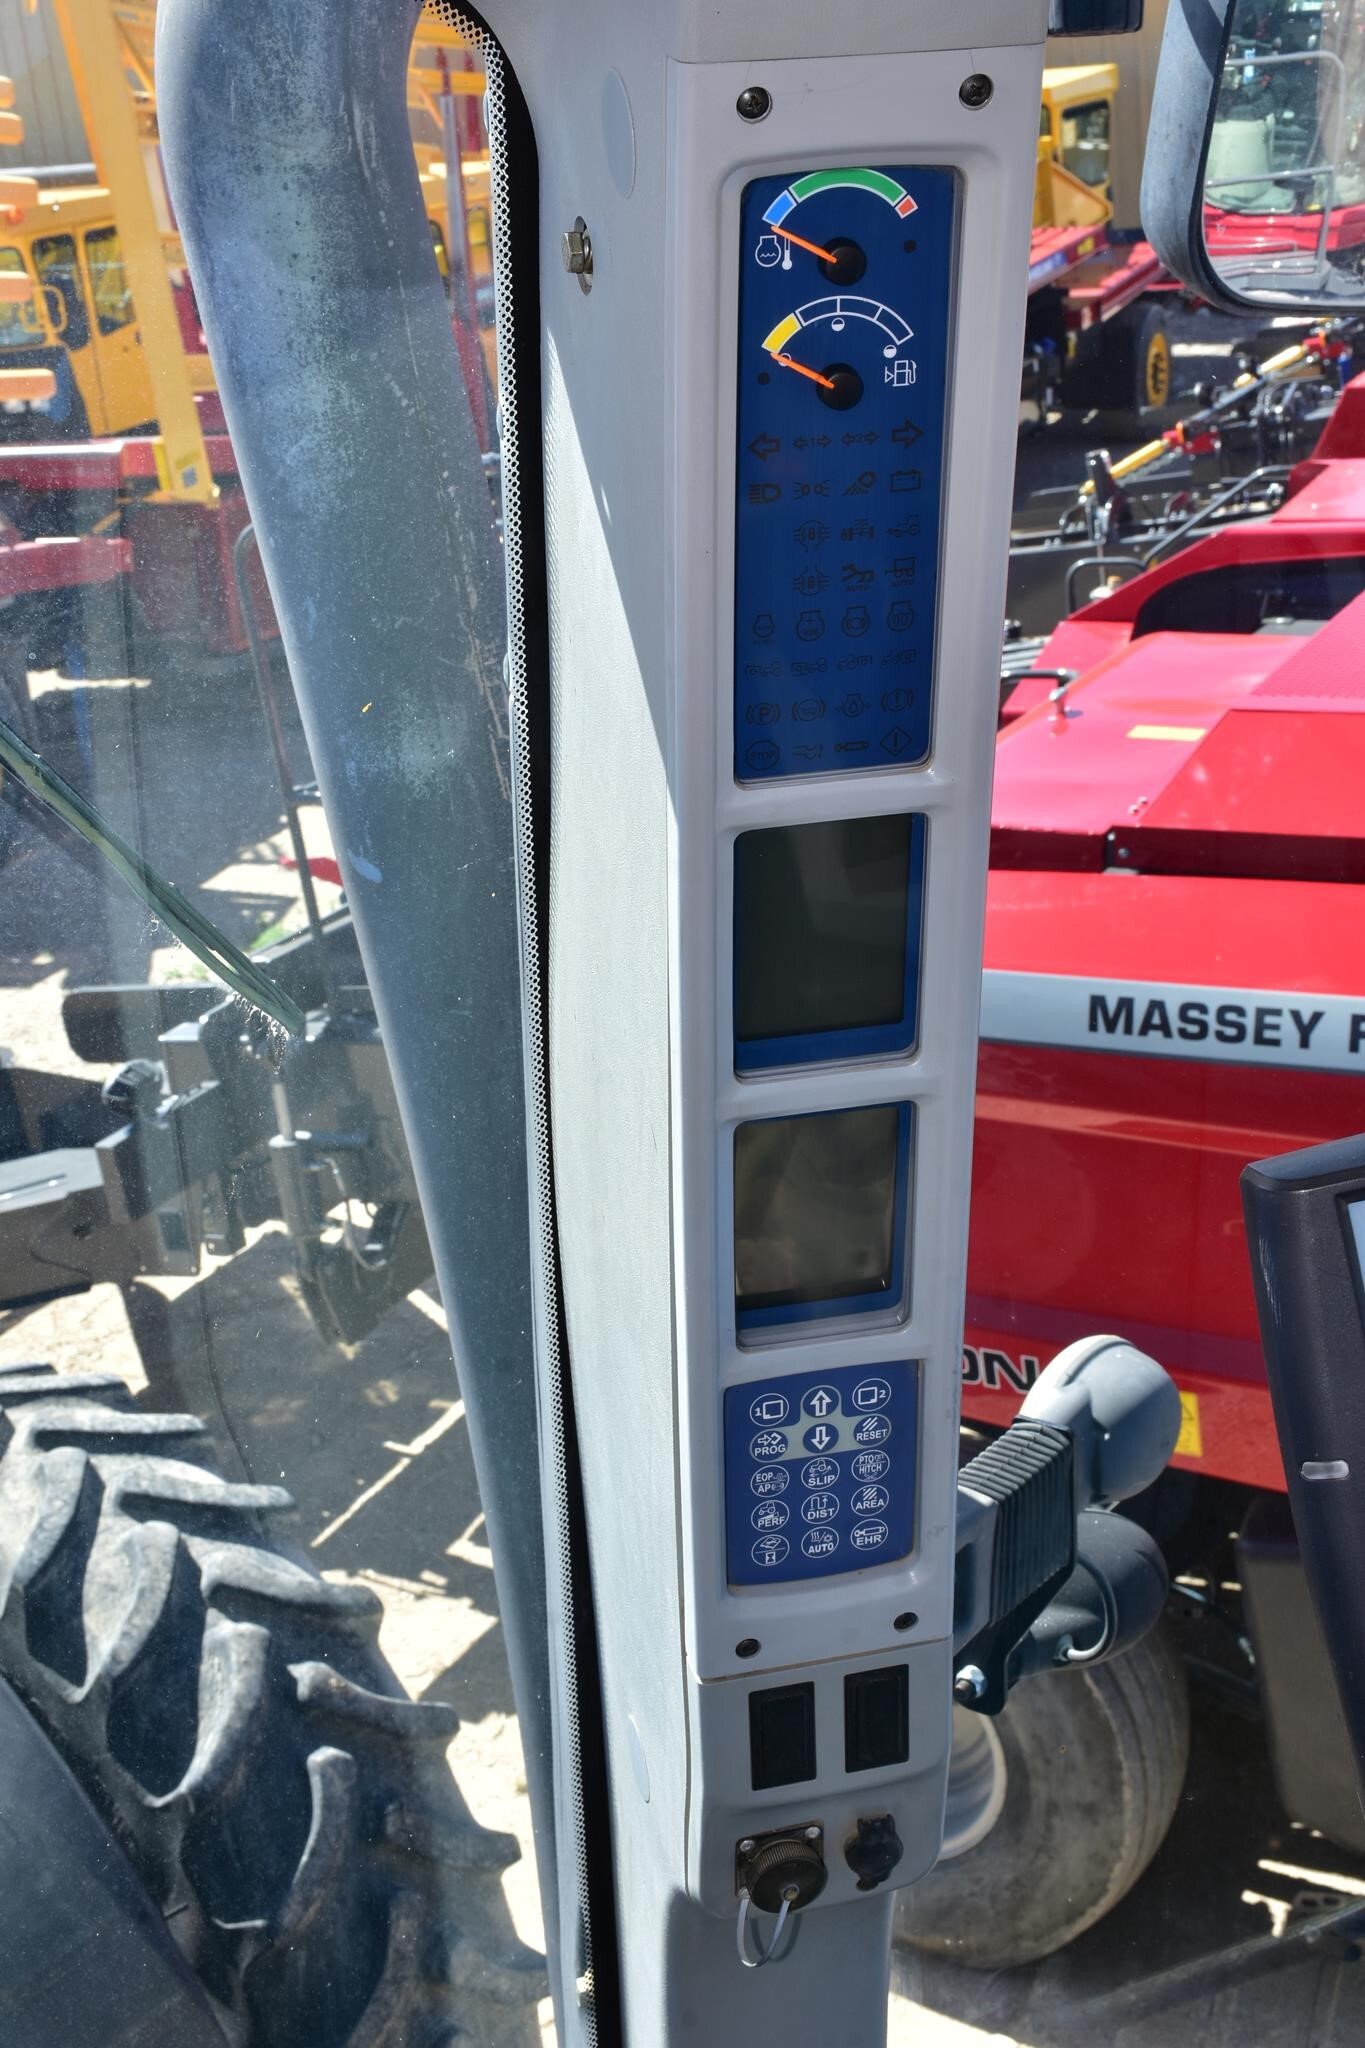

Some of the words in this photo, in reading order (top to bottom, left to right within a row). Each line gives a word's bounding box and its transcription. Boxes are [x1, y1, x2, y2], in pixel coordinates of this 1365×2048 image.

[1088, 994, 1326, 1050] MASSEY
[879, 1390, 886, 1399] 2
[754, 1407, 762, 1417] 1
[856, 1428, 888, 1441] RESET
[754, 1444, 786, 1457] PROG
[859, 1454, 873, 1464] PTO
[859, 1463, 882, 1474] HITCH
[808, 1475, 835, 1487] SLIP
[855, 1499, 885, 1510] AREA
[807, 1508, 835, 1520] DIST
[757, 1516, 785, 1528] PERF
[856, 1534, 882, 1546] EHR
[808, 1542, 834, 1554] AUTO
